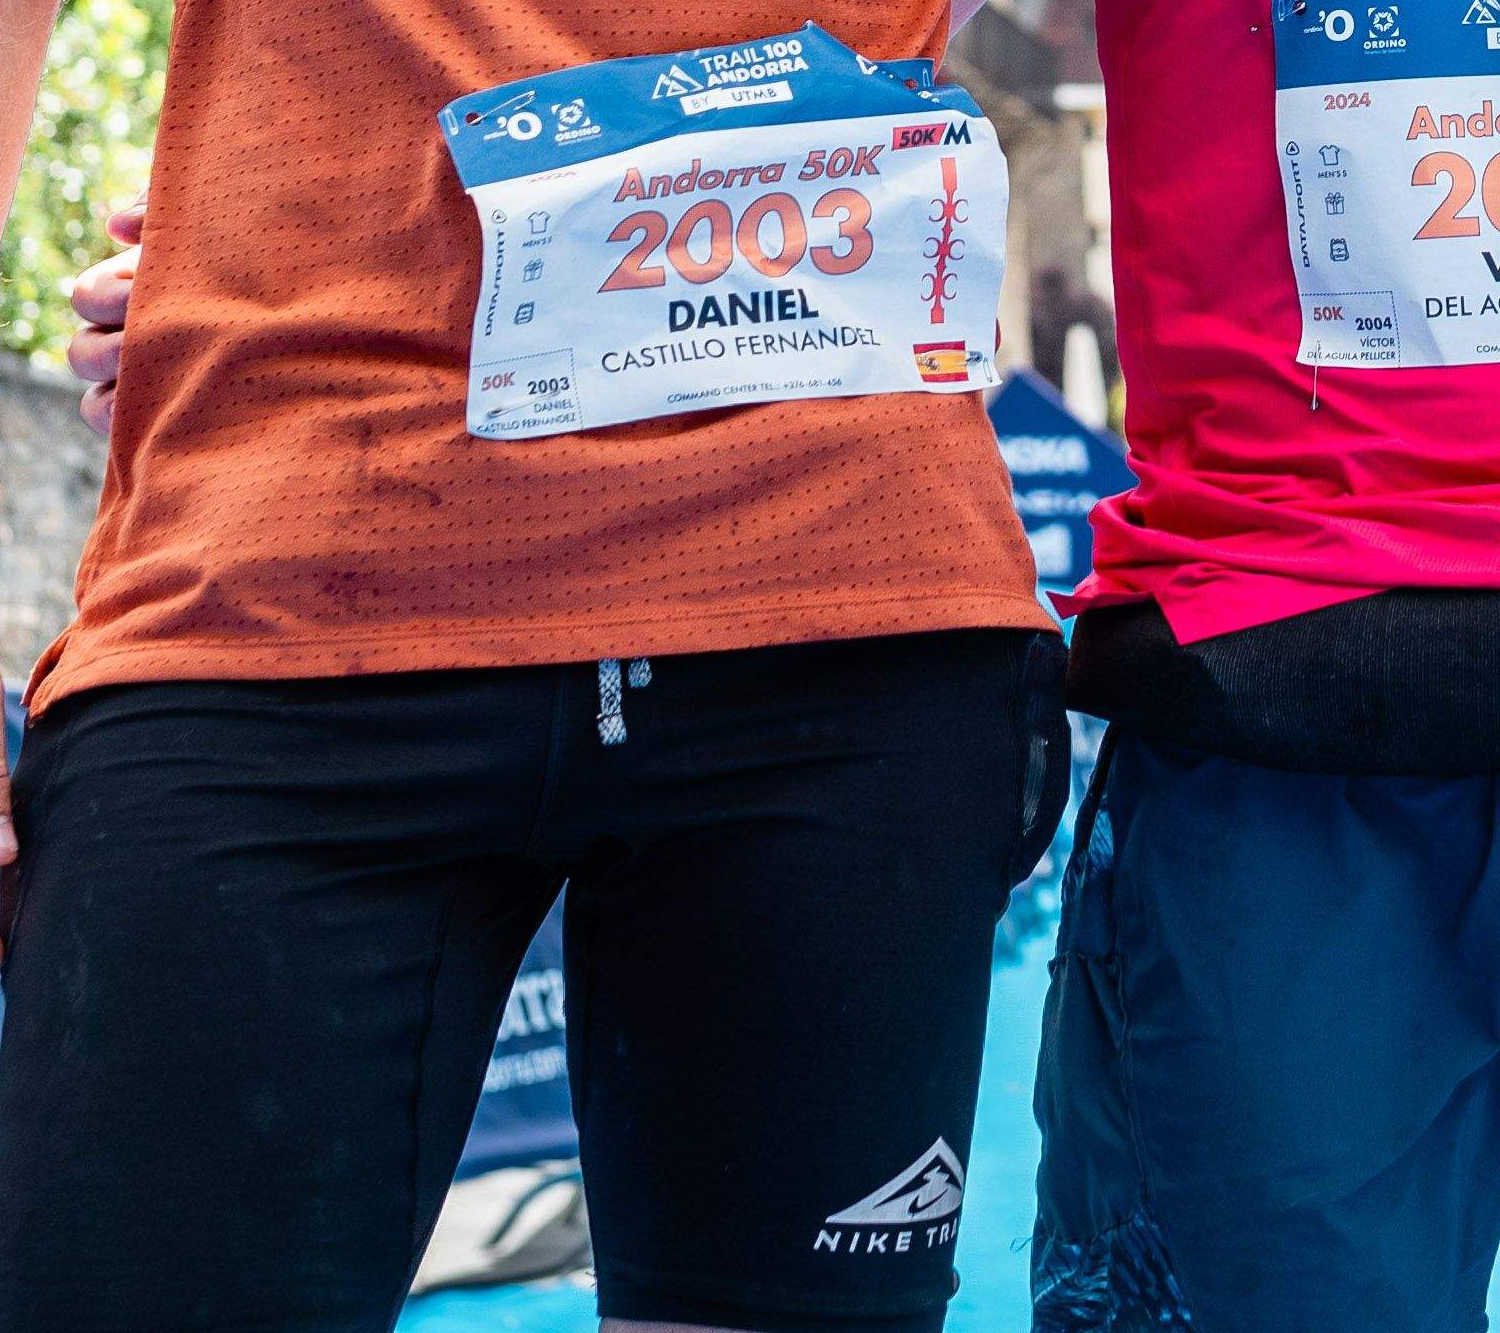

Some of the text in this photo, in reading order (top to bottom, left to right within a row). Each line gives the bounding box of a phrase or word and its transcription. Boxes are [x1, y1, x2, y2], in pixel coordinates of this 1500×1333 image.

[1363, 38, 1407, 50] ORDINO
[699, 39, 803, 74] TRAIL 100
[706, 56, 809, 88] ANDORRA
[731, 88, 777, 103] UTMB
[1323, 91, 1372, 111] 2024
[900, 119, 972, 149] 50K M
[613, 144, 886, 203] Andorra 50K
[597, 188, 874, 294] 2003
[668, 288, 820, 333] DANIEL
[1313, 306, 1344, 322] 50K
[1425, 296, 1473, 319] DEL
[1354, 316, 1393, 332] 2004
[600, 325, 882, 374] CASTILLO FERNANDEZ
[1324, 351, 1358, 361] AGUILA
[1360, 350, 1396, 360] PELLICER
[481, 370, 516, 392] 50K
[527, 376, 571, 396] 2003
[666, 388, 721, 404] COMMAND
[722, 383, 757, 398] CENTER
[533, 398, 575, 414] DANIEL
[813, 1229, 913, 1254] NIKE
